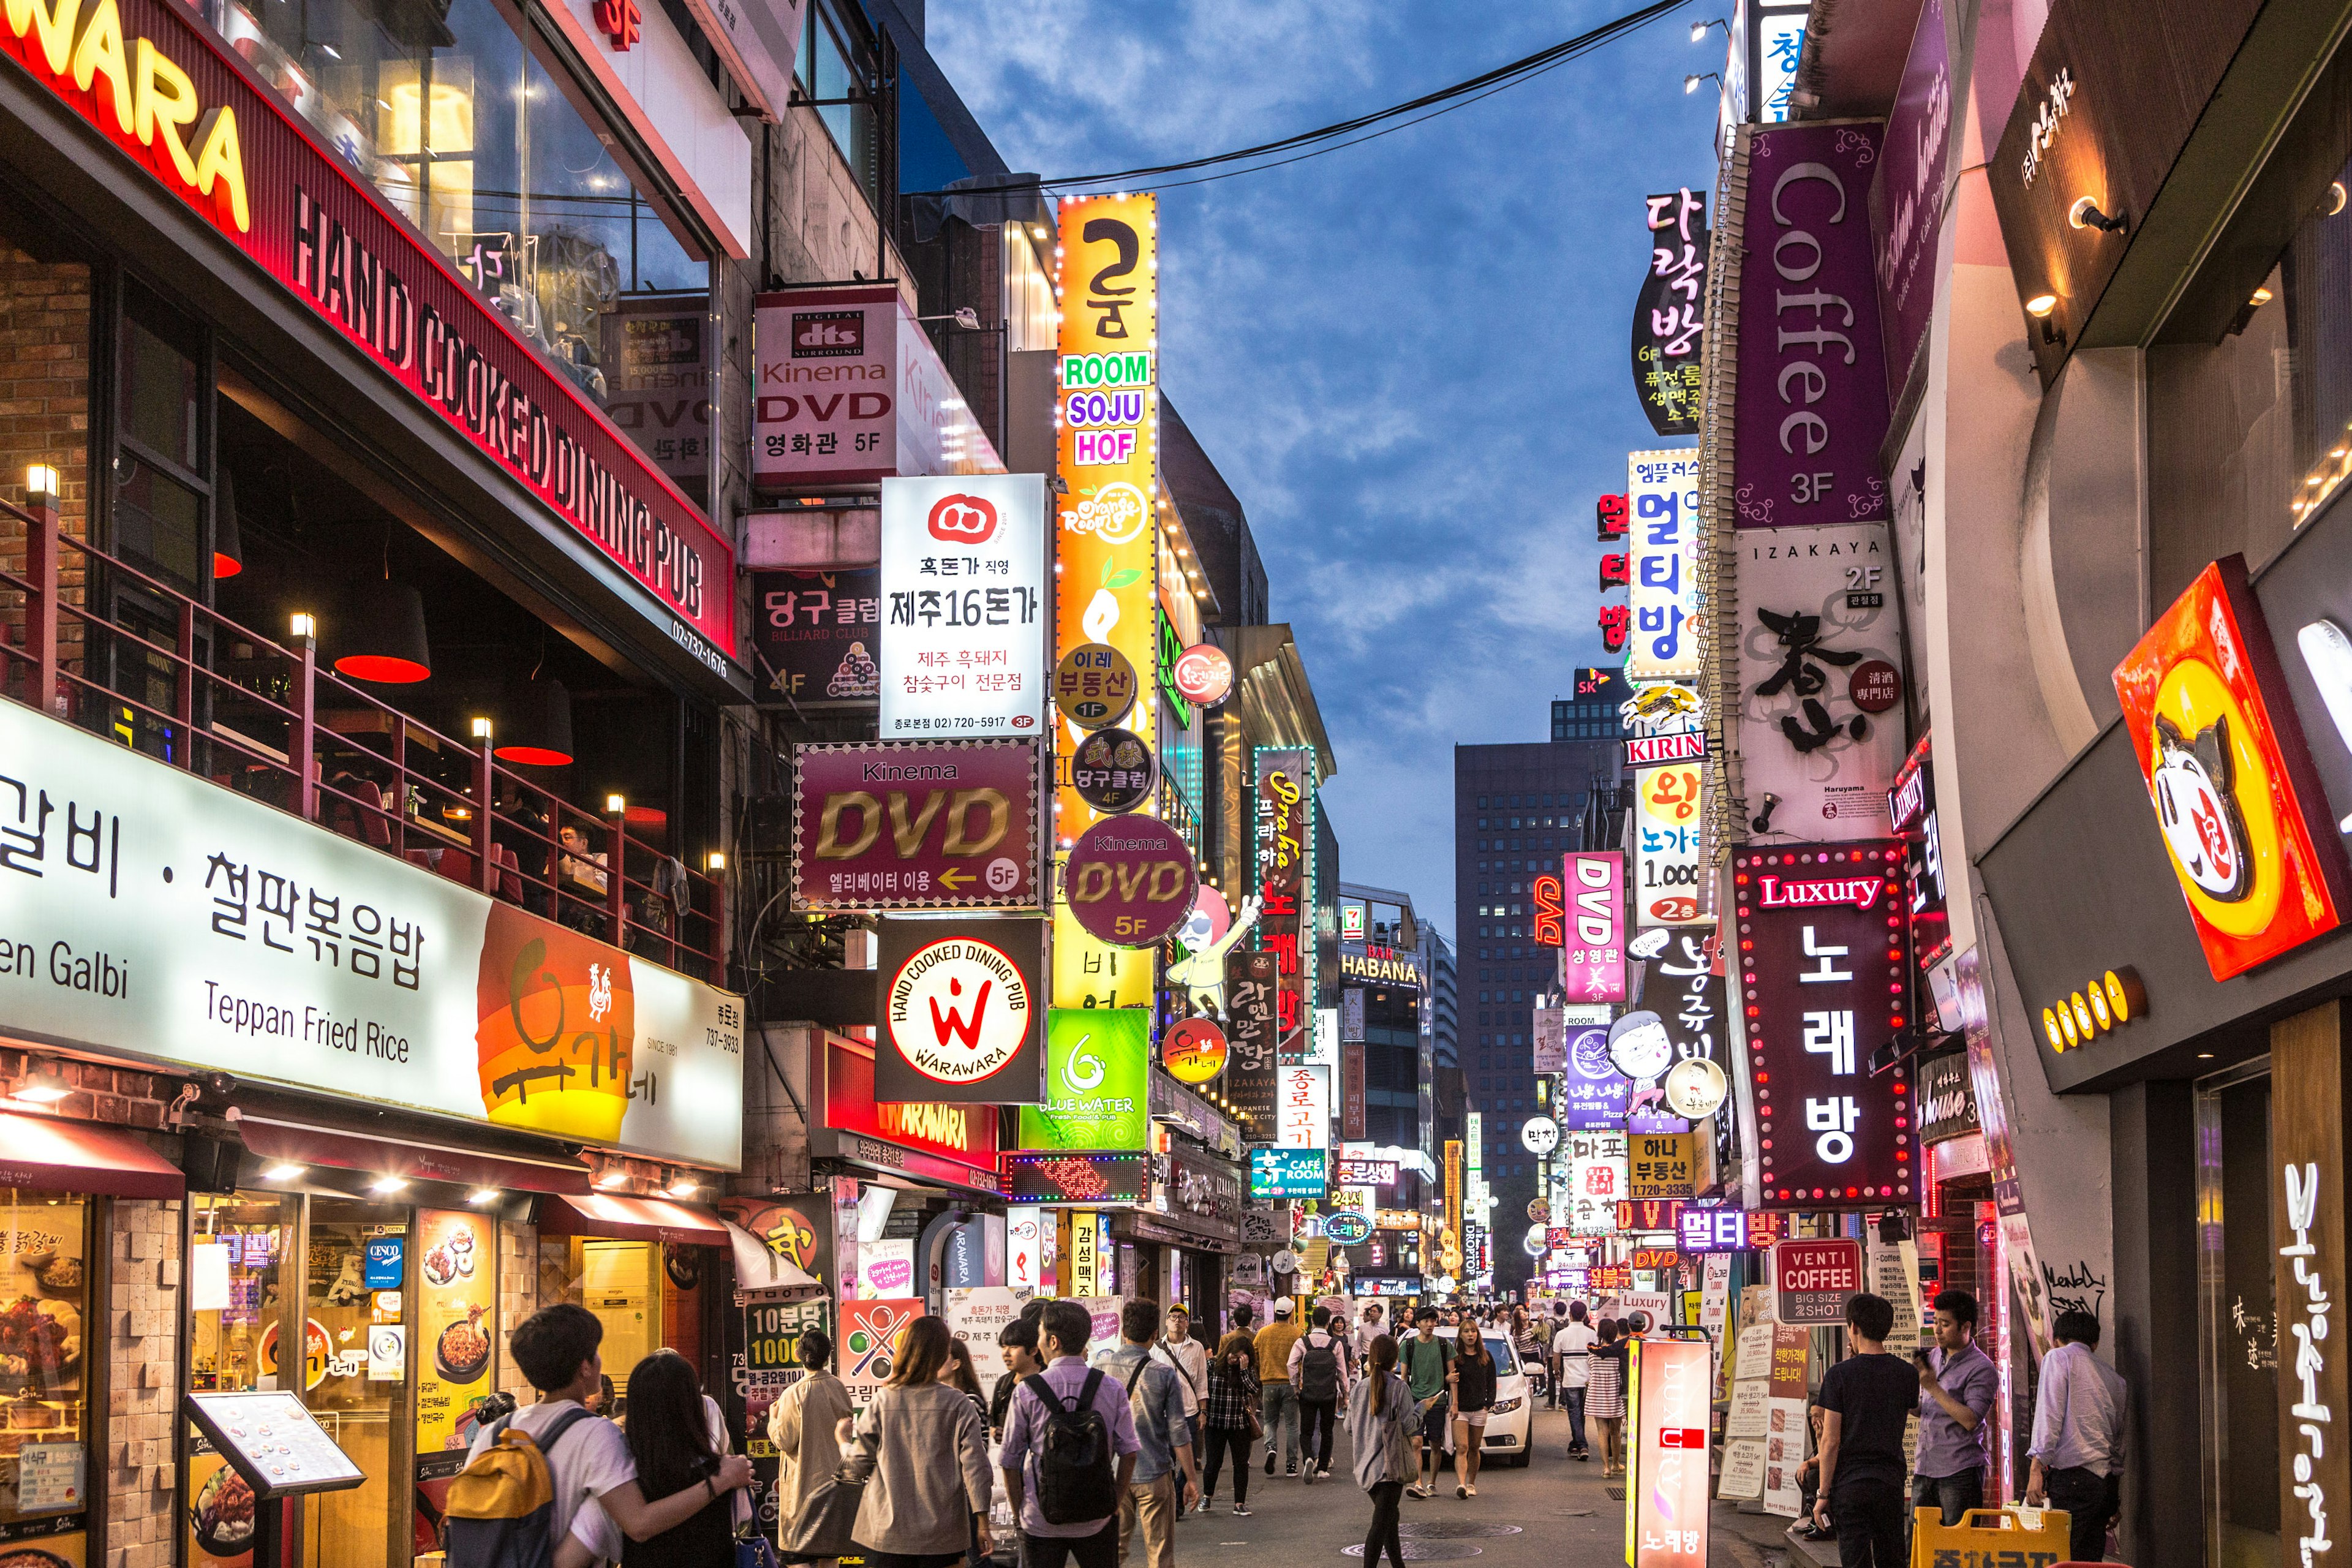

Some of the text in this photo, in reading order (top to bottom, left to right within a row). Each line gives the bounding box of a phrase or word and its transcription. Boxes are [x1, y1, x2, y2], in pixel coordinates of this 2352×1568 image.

[1083, 218, 1139, 339] 룸
[1647, 187, 1704, 358] 다락방
[795, 312, 861, 322] DIGITAL
[1771, 162, 1856, 455] Coffee
[798, 324, 857, 345] dts
[794, 349, 862, 357] SURROUND
[1638, 346, 1658, 362] 6F
[763, 363, 886, 384] Kinema
[1066, 355, 1147, 385] ROOM
[293, 184, 703, 620] HAND COOKED DINING PUB
[756, 393, 892, 423] DVD
[1070, 394, 1141, 423] SOJU
[1667, 407, 1700, 423] 소주
[765, 432, 881, 457] 영화관 5F
[1079, 433, 1133, 461] HOF
[1637, 461, 1700, 484] 엠플러스
[1790, 472, 1834, 503] 3F
[1754, 541, 1880, 560] IZAKAYA
[985, 559, 1009, 575] 직영
[1637, 492, 1685, 660] 멀티방
[1845, 565, 1883, 591] 2F
[764, 589, 833, 630] 당구
[890, 586, 1038, 628] 제주16돈가
[1850, 595, 1879, 606] 관철점
[772, 627, 869, 643] BILLIARD CLUB
[671, 620, 727, 678] 02-732-1676
[918, 649, 1008, 668] 제주 흑돼지
[1074, 651, 1112, 669] 이레
[770, 668, 805, 695] 4F
[903, 673, 1022, 693] 참숯구이 전문점
[1059, 672, 1128, 697] 부동산
[1578, 681, 1597, 693] SK
[1856, 687, 1894, 700] 專門店
[1080, 704, 1103, 717] 1F
[894, 717, 1006, 729] 종로본점 720-5917
[1016, 717, 1032, 727] 3F
[1629, 733, 1705, 764] KIRIN
[863, 763, 959, 782] Kinema
[1076, 770, 1147, 789] 당구클럽
[1652, 771, 1702, 819] 왕
[1888, 767, 1924, 832] Luxury
[815, 788, 1011, 861] DVD
[1270, 771, 1300, 870] Praha
[1258, 799, 1277, 867] 프라하
[1095, 837, 1167, 851] Kinema
[830, 867, 1014, 894] 엘리베이터 이용 5F
[1074, 861, 1186, 903] DVD
[1575, 857, 1613, 947] DVD
[1762, 878, 1880, 907] Luxury
[1660, 900, 1695, 919] 2층
[205, 851, 425, 991] 철판볶음밥
[1115, 916, 1147, 935] 5F
[1366, 943, 1394, 960] BAR
[1571, 948, 1619, 965] 상영관
[50, 941, 127, 1000] Galbi
[1341, 954, 1418, 983] HABANA
[1585, 965, 1609, 993] 美
[892, 944, 1025, 1022] HAND COOKED DINING PUB
[1592, 992, 1604, 1002] 3F
[204, 980, 410, 1064] Teppan Fried Rice
[493, 937, 657, 1106] 유가네
[718, 1004, 739, 1030] 종로점
[647, 1037, 679, 1057] SINCE 1981
[706, 1027, 739, 1055] 737-3933
[1169, 1030, 1216, 1069] 유가네
[1799, 925, 1861, 1164] 노래방
[916, 1047, 1007, 1076] WARAWARA
[1229, 1078, 1276, 1087] IZAKAYA
[1039, 1097, 1134, 1114] BLUE WATER
[1286, 1069, 1316, 1149] 종로고기
[1348, 1093, 1361, 1126] 피부과
[1528, 1123, 1556, 1145] 막창
[1656, 1120, 1664, 1129] &
[1574, 1139, 1625, 1159] 마포
[1644, 1139, 1678, 1158] 하나
[1290, 1157, 1321, 1170] CAFÉ
[1637, 1162, 1687, 1181] 부동산
[969, 1169, 998, 1191] 02-732-1676
[1287, 1169, 1324, 1180] ROOM
[1330, 1191, 1363, 1207] 24시
[1632, 1183, 1693, 1196] T.720-3335
[1329, 1223, 1366, 1237] 노래방
[1683, 1212, 1781, 1248] 멀티방
[13, 1231, 63, 1254] 닭갈비
[370, 1245, 399, 1257] CESCO
[1465, 1224, 1476, 1276] DROPTOP
[1237, 1263, 1257, 1272] Asahi
[1635, 1250, 1678, 1268] DVD
[1792, 1251, 1846, 1266] VENTI
[1880, 1254, 1901, 1262] Coffee
[1710, 1281, 1722, 1291] 1,000
[1785, 1268, 1853, 1289] COFFEE
[1623, 1294, 1667, 1311] Luxury
[1795, 1292, 1842, 1304] BIG SIZE
[753, 1305, 822, 1333] 10분당
[995, 1305, 1010, 1315] 직영
[1708, 1307, 1721, 1317] 7,000
[1795, 1304, 1842, 1317] 2SHOT
[2232, 1295, 2247, 1335] 味
[972, 1332, 991, 1341] 제주
[1775, 1348, 1807, 1364] 착한가격에
[2247, 1337, 2260, 1370] 迷
[1774, 1366, 1802, 1382] 드립니다!
[1661, 1361, 1684, 1490] LUXURY
[1640, 1529, 1700, 1555] 노래방
